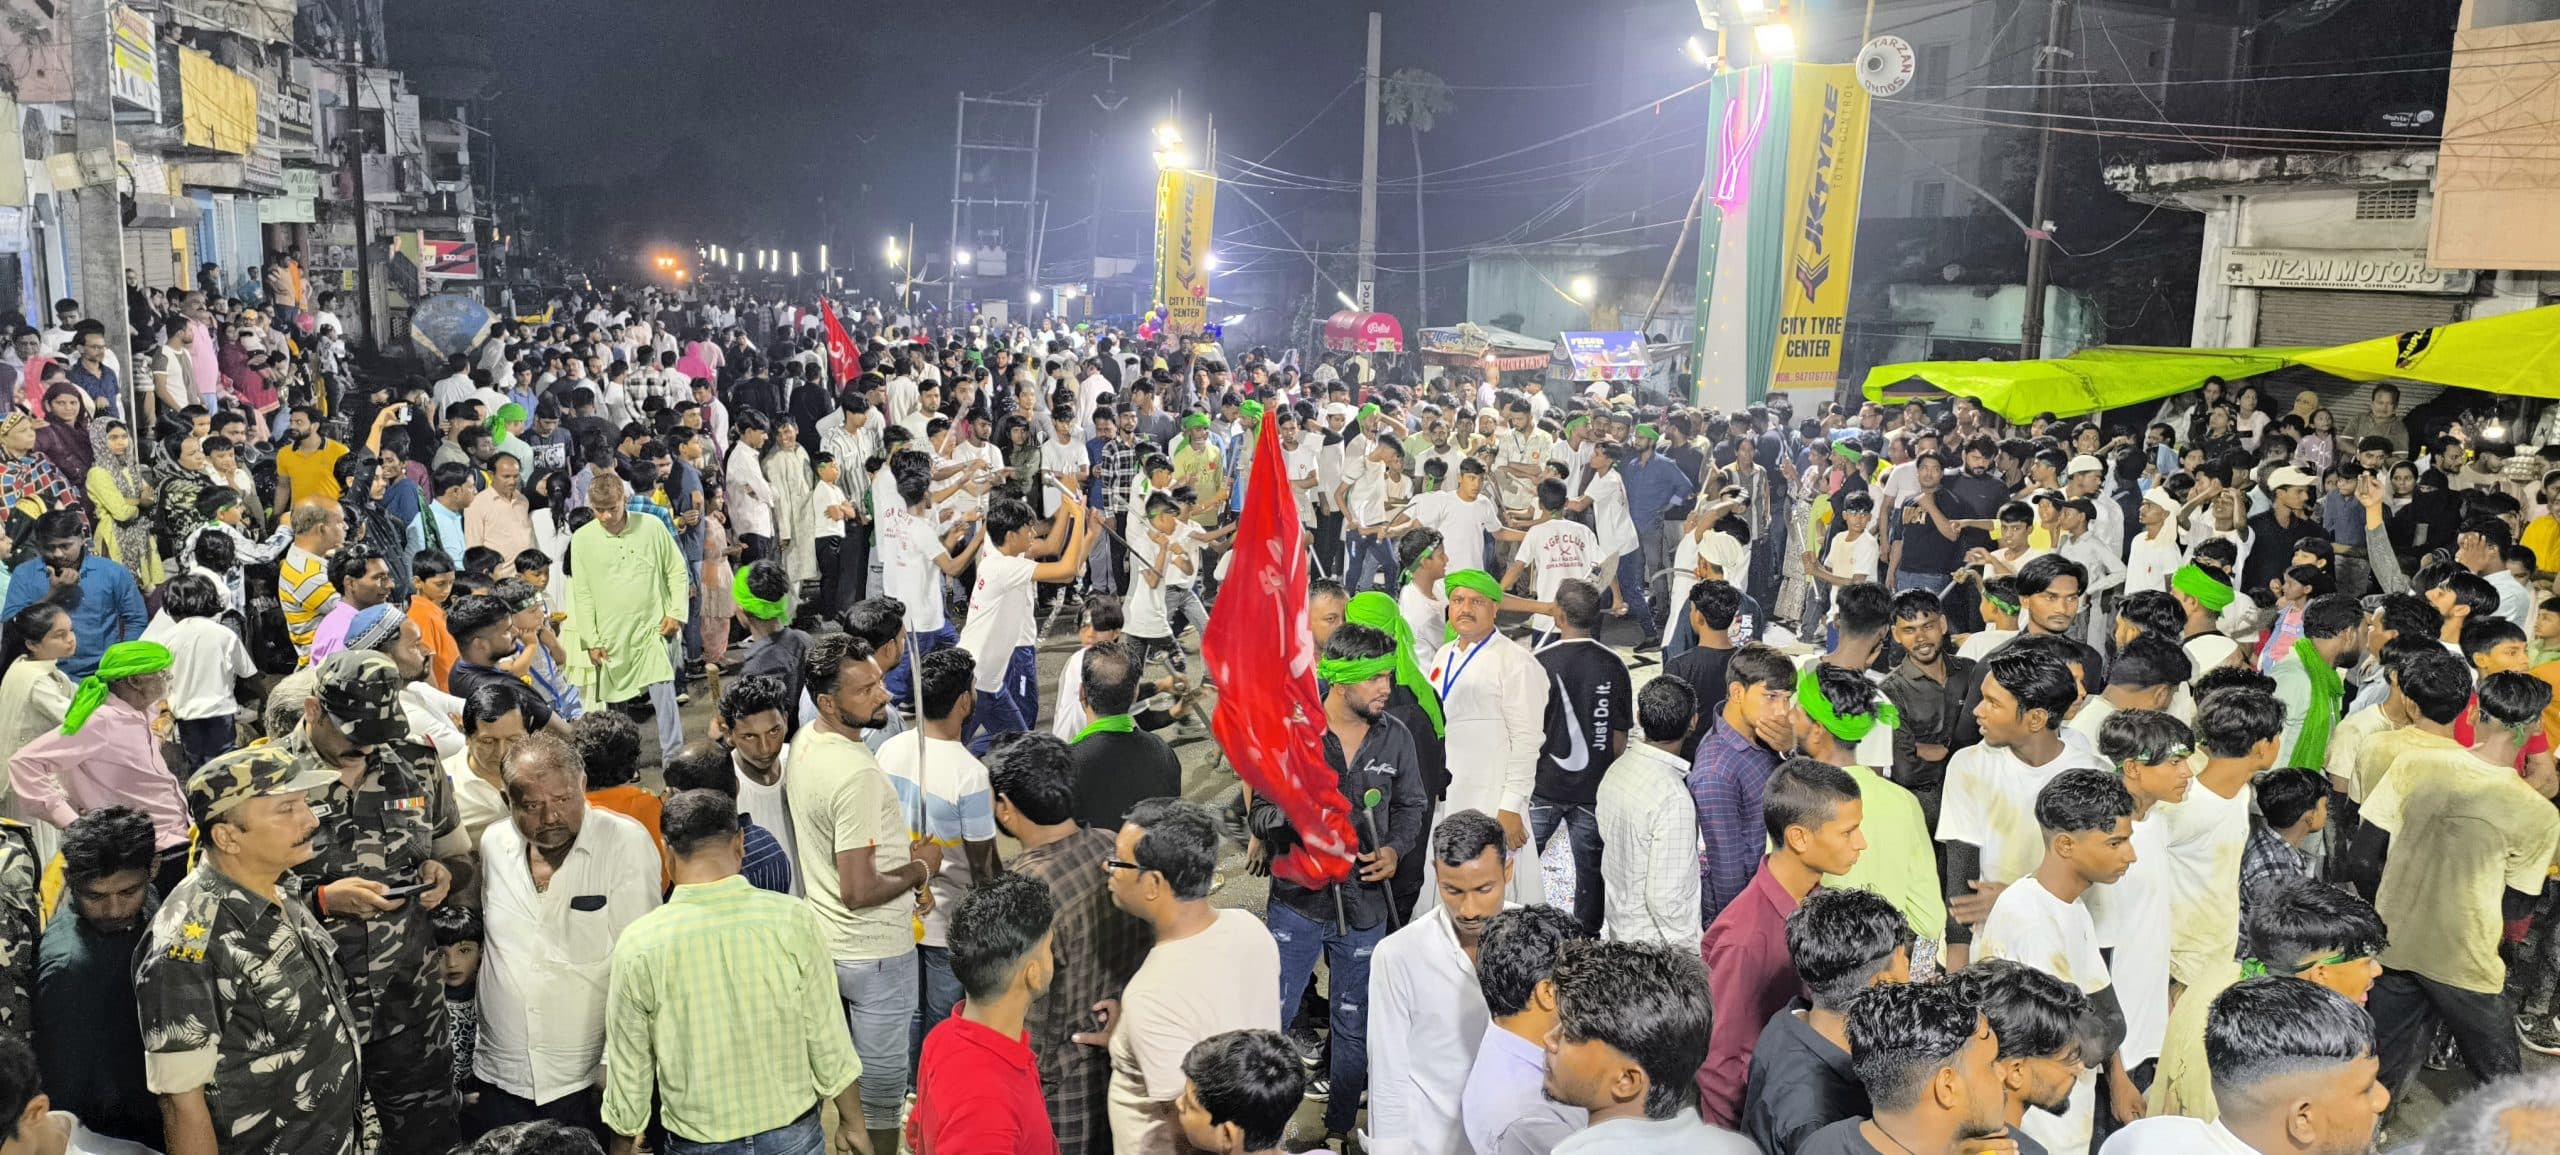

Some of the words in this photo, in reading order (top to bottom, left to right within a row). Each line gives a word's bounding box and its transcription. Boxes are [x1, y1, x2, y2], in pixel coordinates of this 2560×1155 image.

[1870, 38, 1912, 73] TARZAN
[1864, 76, 1905, 93] SOUND
[2258, 259, 2334, 281] NIZAM
[2335, 260, 2440, 284] MOTORS
[1168, 297, 1185, 307] CITY
[1186, 297, 1207, 307] TYRE
[1173, 308, 1201, 318] CENTER
[1780, 316, 1807, 335] CITY
[1811, 316, 1842, 335] TYRE
[1786, 339, 1831, 358] CENTER
[1562, 534, 1586, 552] CLUB
[1593, 698, 1609, 718] Do
[1592, 720, 1608, 751] Just
